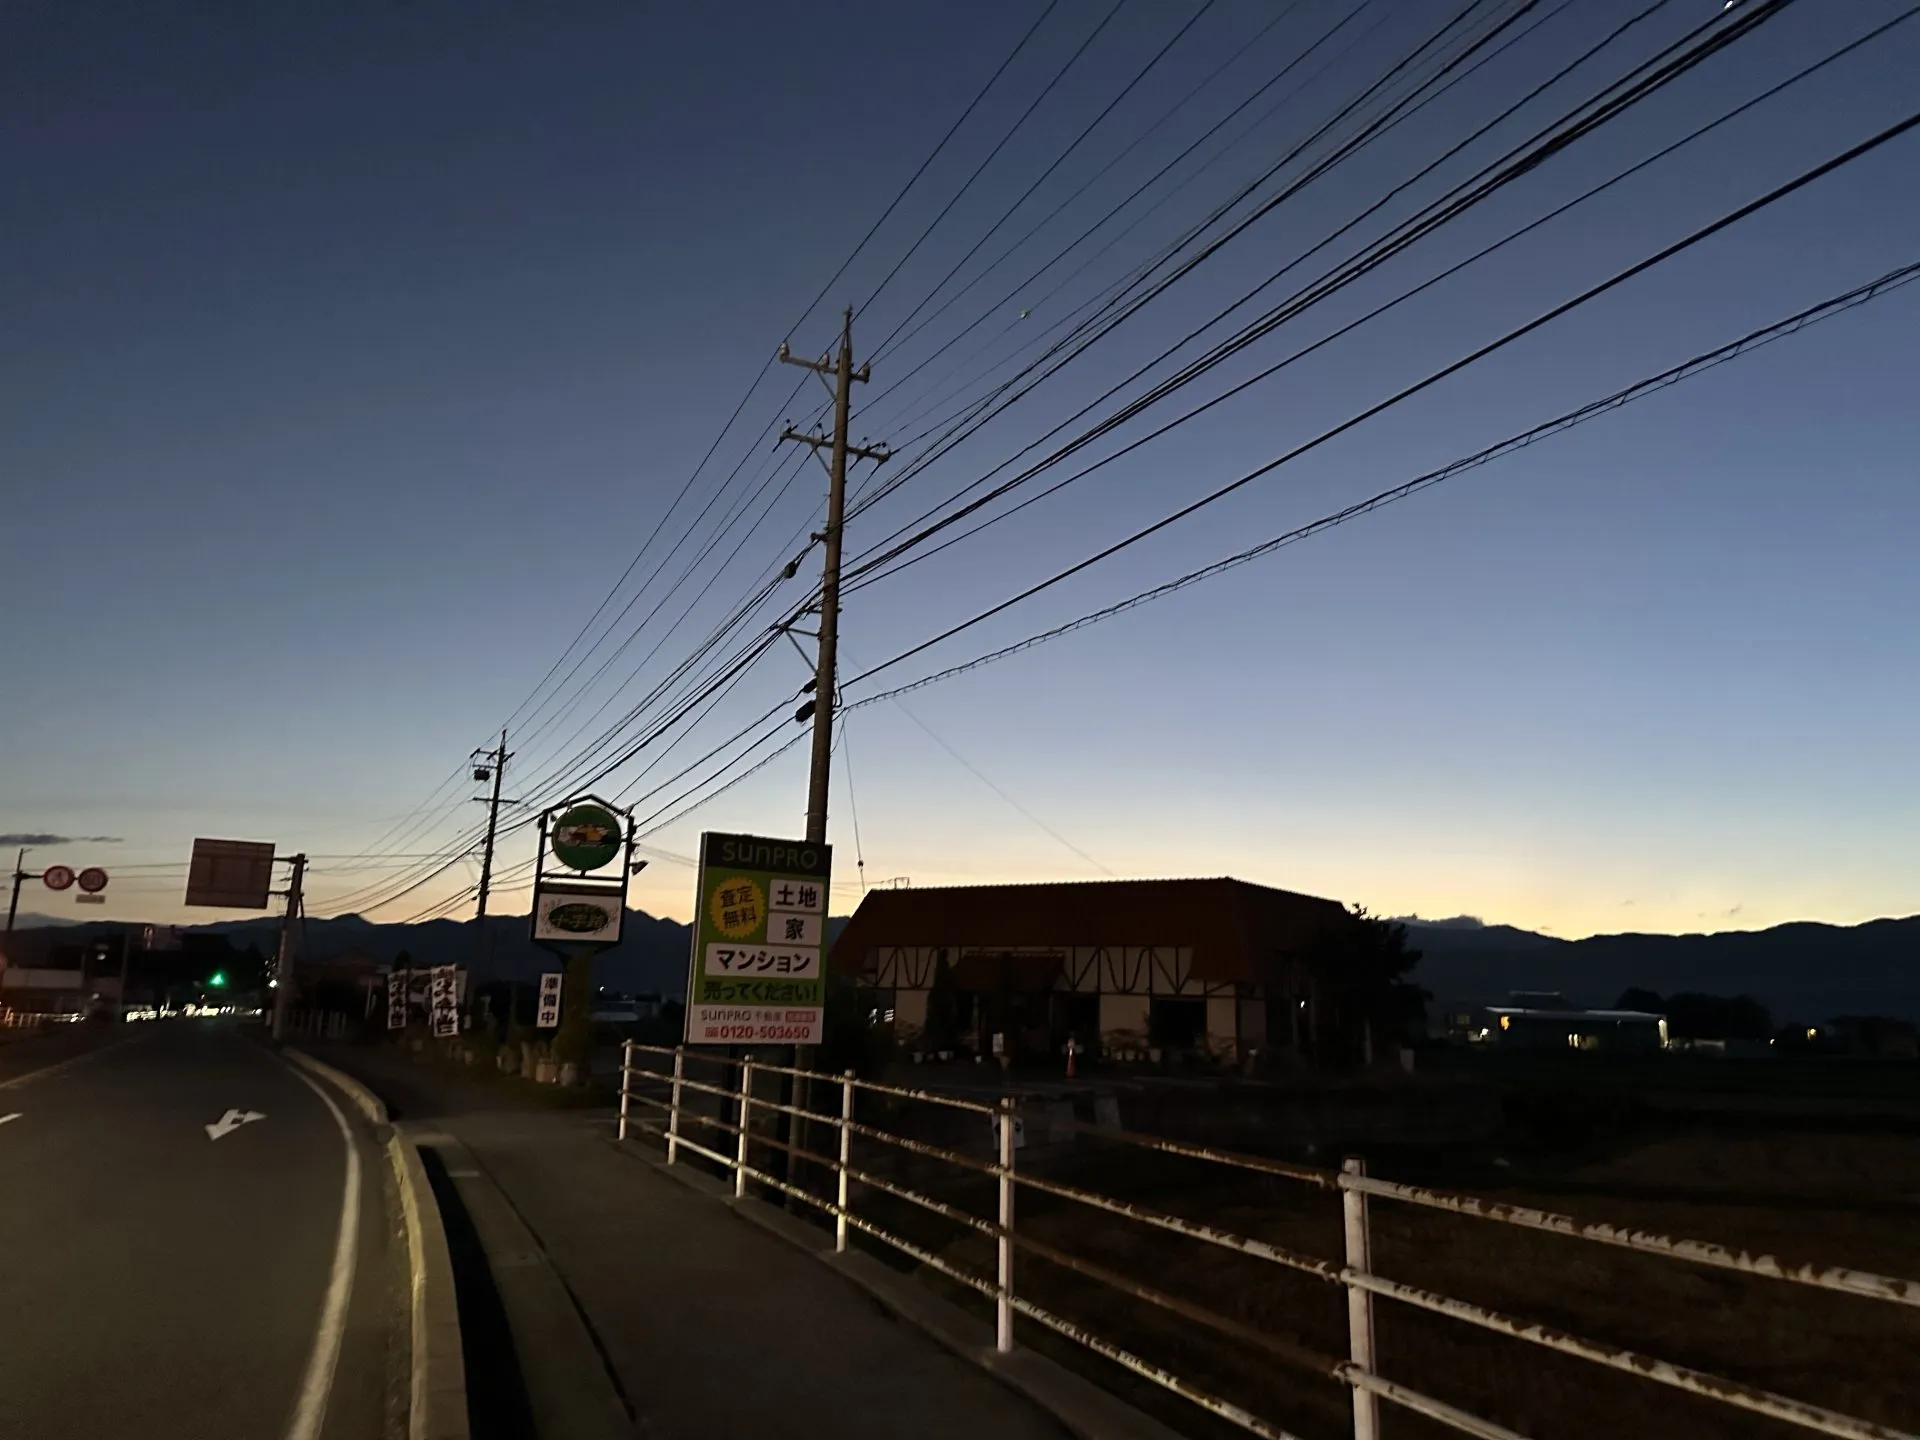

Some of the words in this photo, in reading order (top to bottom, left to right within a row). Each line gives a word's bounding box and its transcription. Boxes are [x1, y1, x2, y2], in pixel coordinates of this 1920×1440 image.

[720, 885, 755, 909] 査定
[776, 884, 817, 908] 土地
[723, 904, 757, 930] 無料
[785, 917, 805, 940] 家
[716, 949, 811, 974] マンション
[541, 976, 559, 1025] 準備中
[720, 1024, 811, 1040] 0120-503650
